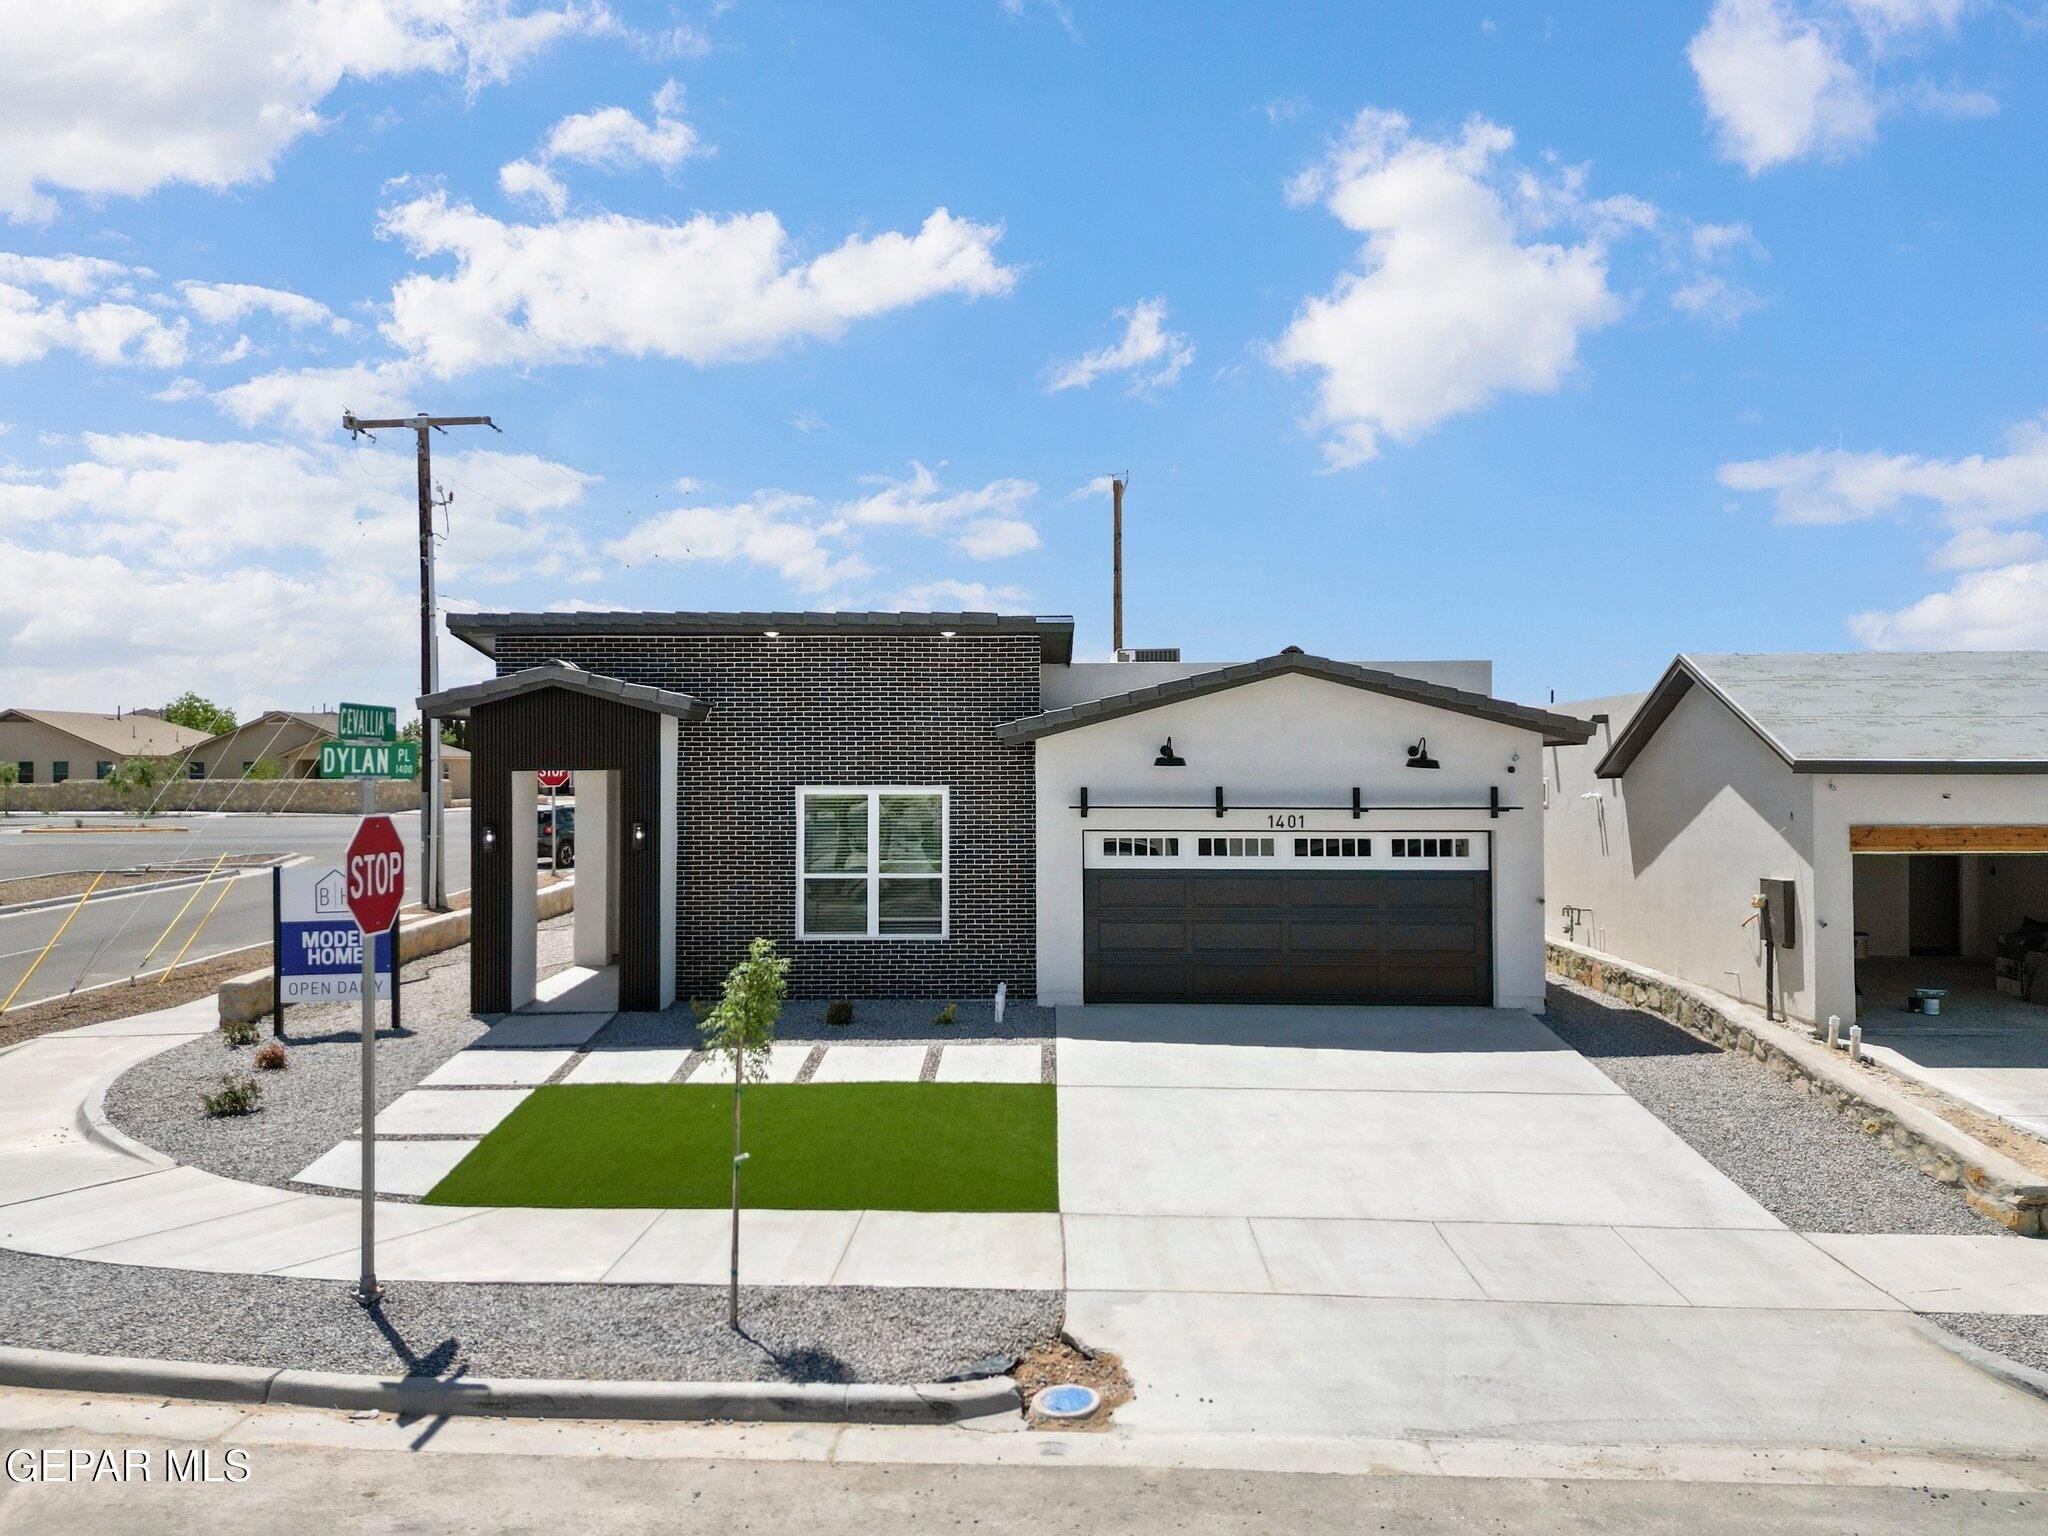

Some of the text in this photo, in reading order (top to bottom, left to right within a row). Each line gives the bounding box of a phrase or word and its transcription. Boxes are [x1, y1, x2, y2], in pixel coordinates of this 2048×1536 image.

[340, 708, 385, 736] CEVALLIA
[323, 747, 410, 774] DYLAN PL
[395, 764, 413, 774] 1400
[1267, 814, 1304, 829] 1401
[350, 851, 401, 899] STOP
[307, 947, 363, 965] HOME
[288, 980, 383, 996] OPEN DAIY
